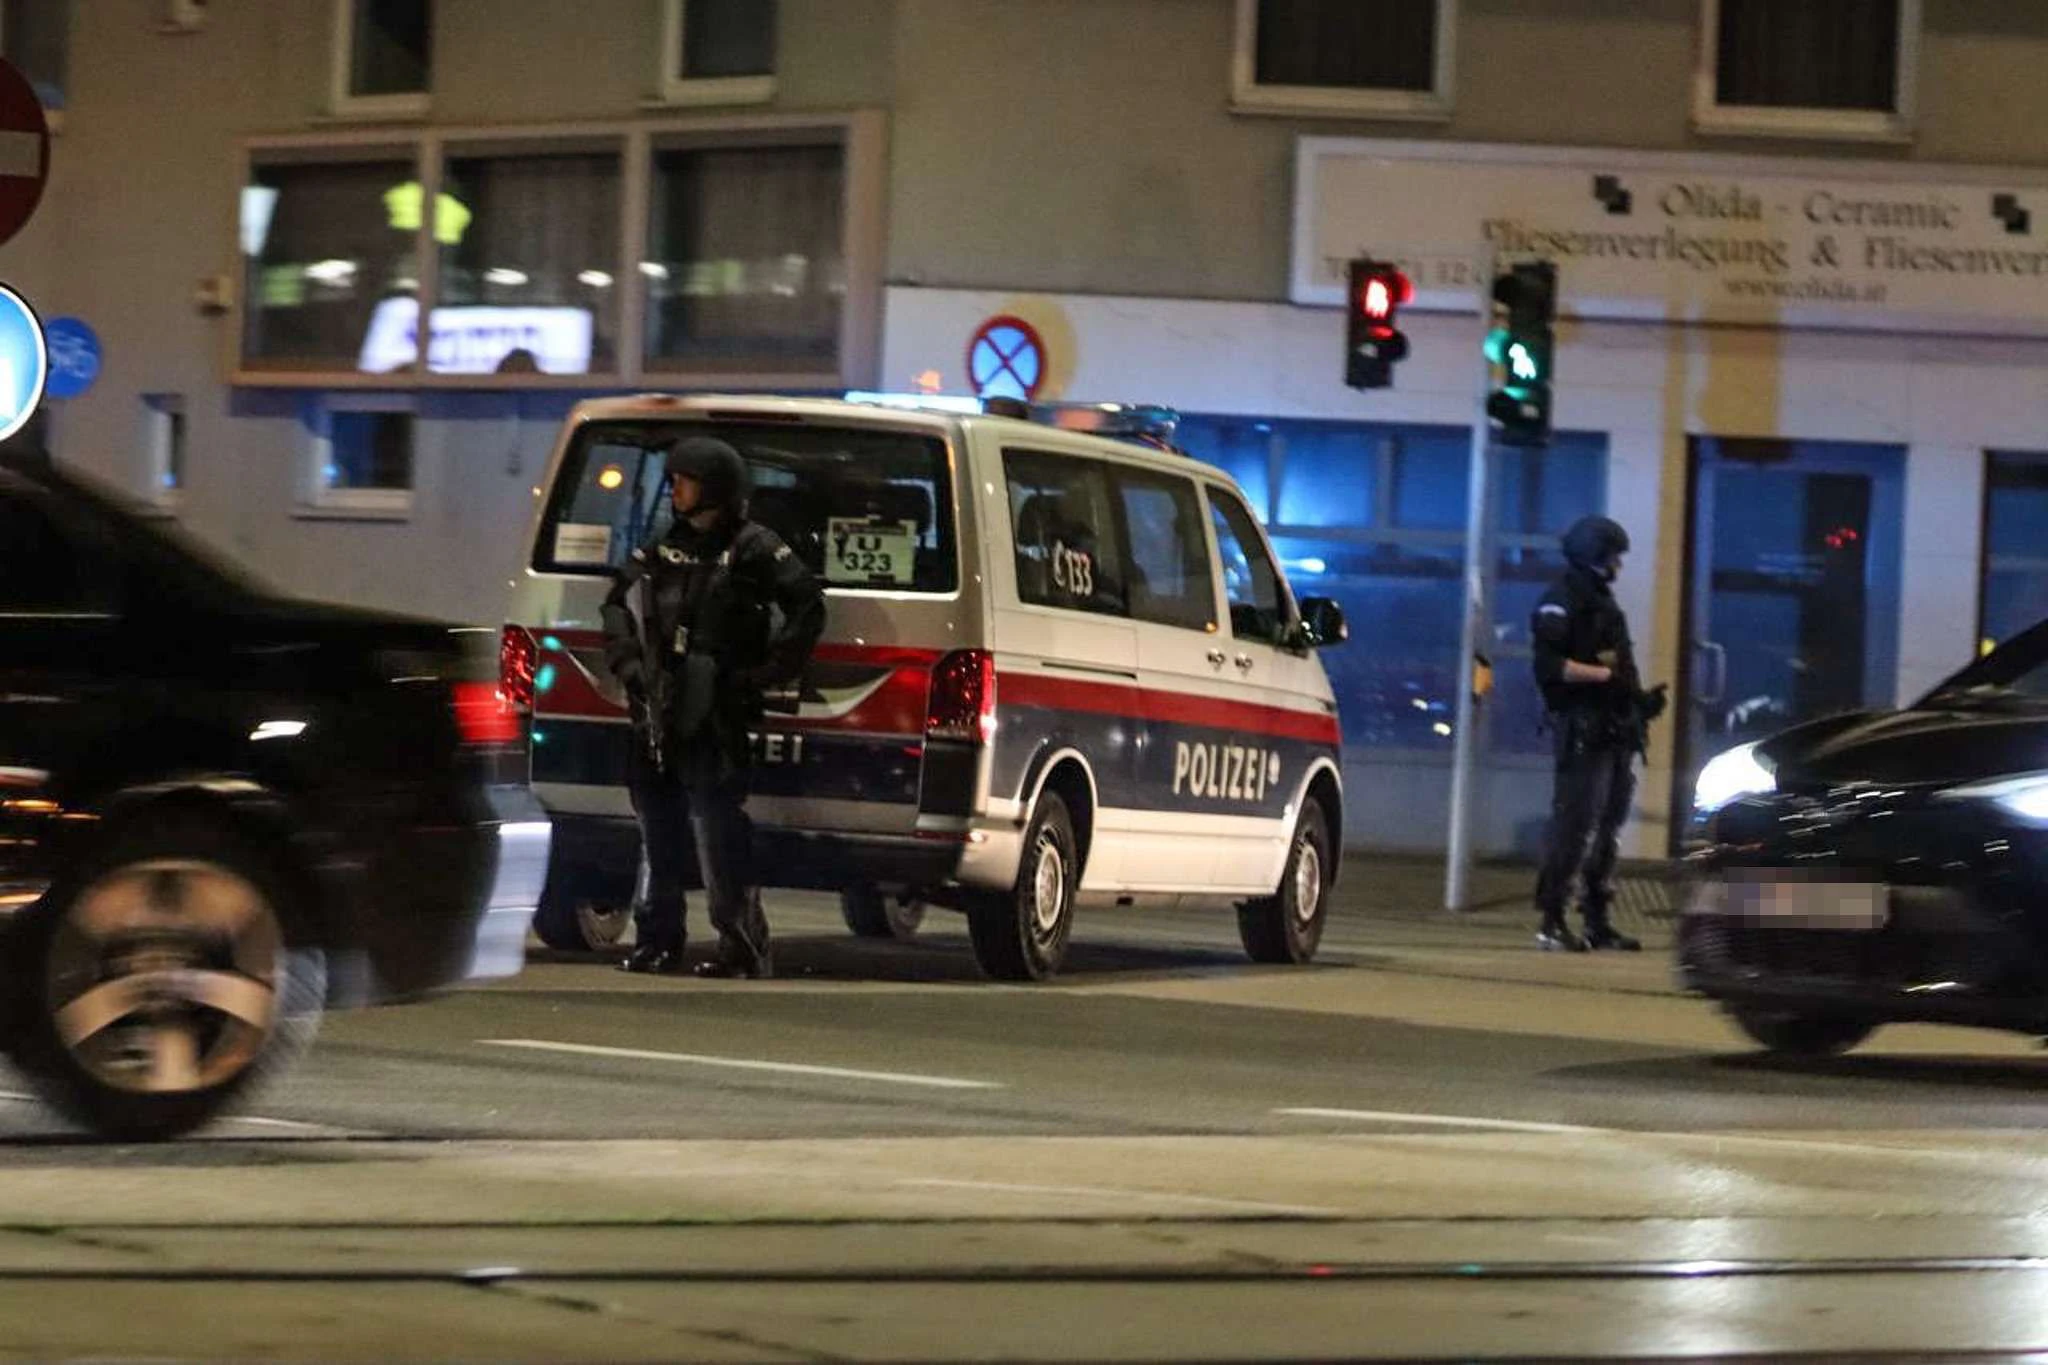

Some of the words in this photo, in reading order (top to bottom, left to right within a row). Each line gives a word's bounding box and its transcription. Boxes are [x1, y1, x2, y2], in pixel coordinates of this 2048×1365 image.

[1658, 182, 1762, 221] Olida
[1801, 189, 1960, 231] Ceramic
[1810, 233, 1839, 269] &
[844, 552, 893, 572] 323
[1064, 548, 1093, 596] 133
[1173, 740, 1268, 802] POLIZEI
